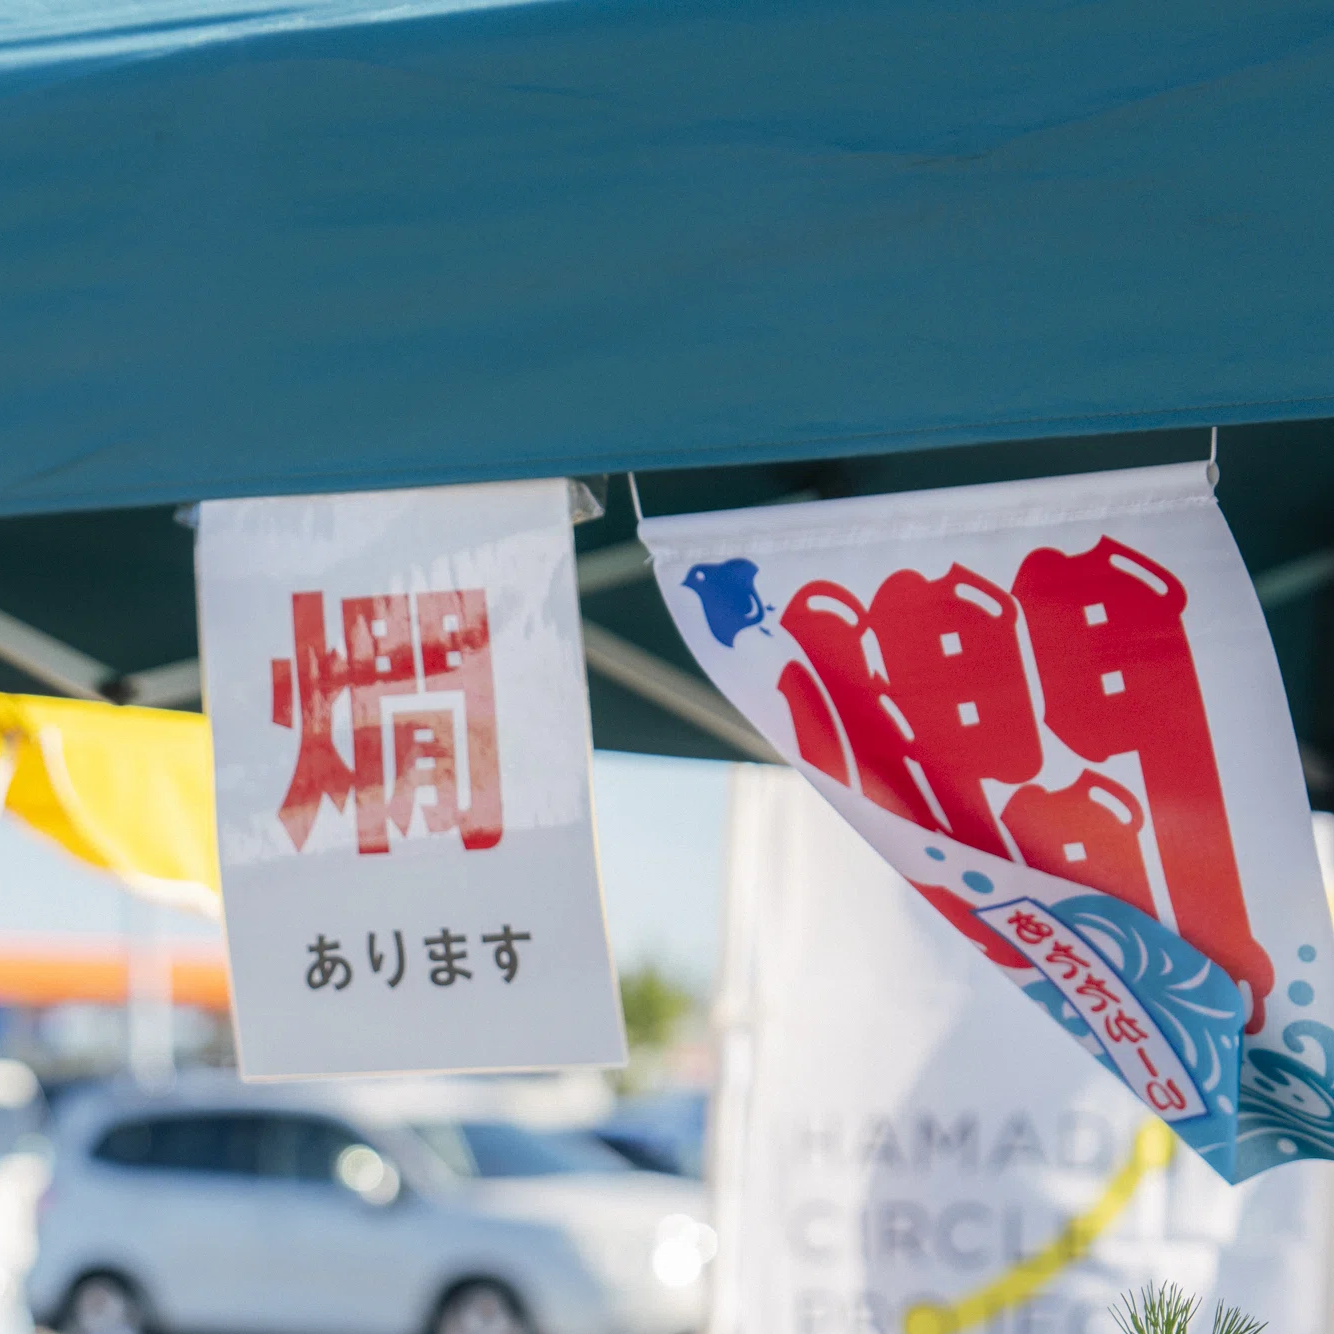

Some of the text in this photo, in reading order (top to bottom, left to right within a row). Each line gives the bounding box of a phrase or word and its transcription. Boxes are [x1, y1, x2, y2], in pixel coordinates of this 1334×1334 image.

[270, 588, 503, 854] 燗
[305, 924, 533, 991] あります
